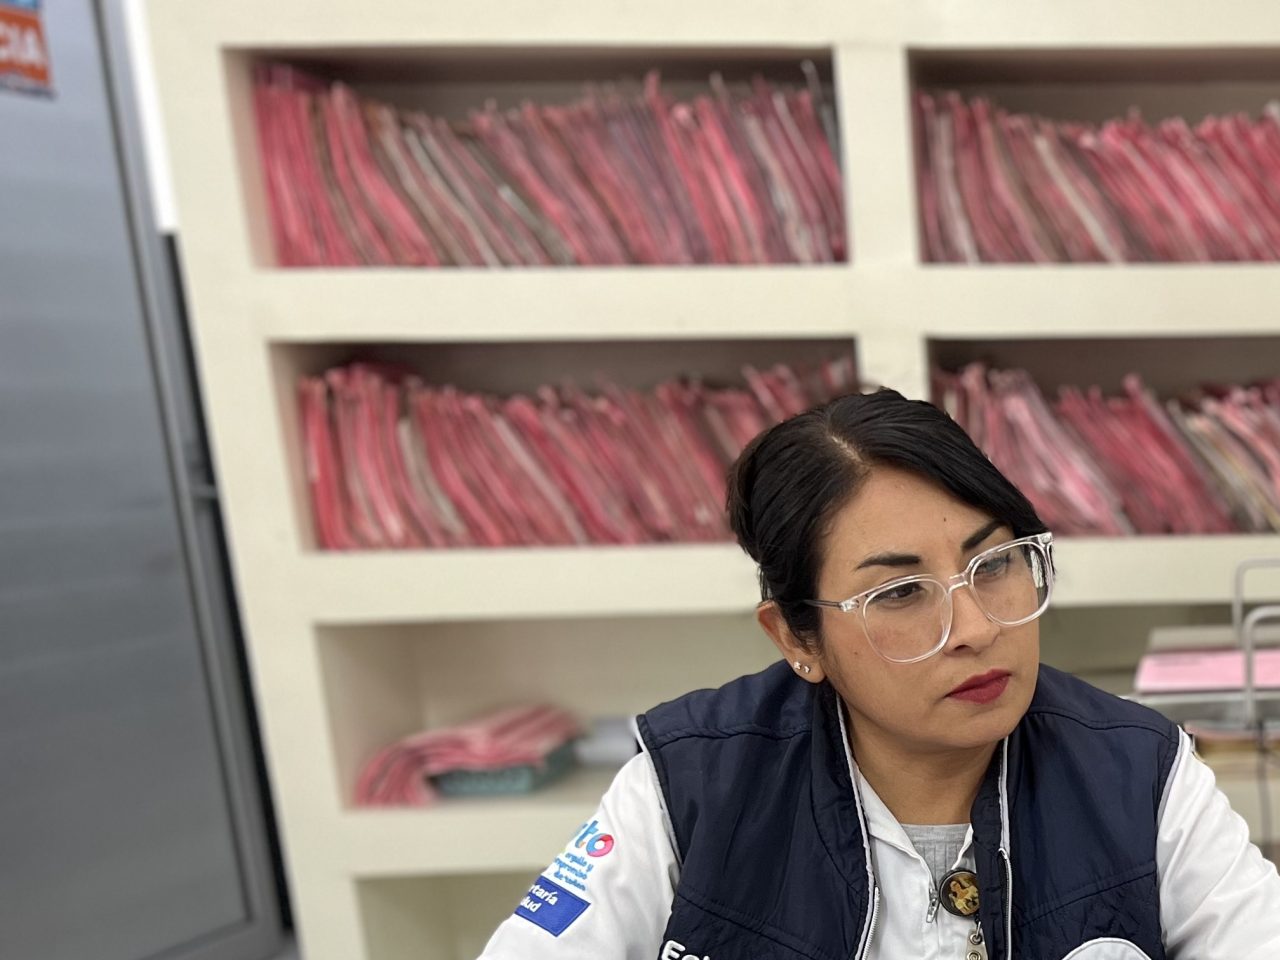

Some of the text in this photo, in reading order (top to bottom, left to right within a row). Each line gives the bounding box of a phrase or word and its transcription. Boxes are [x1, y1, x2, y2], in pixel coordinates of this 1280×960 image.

[575, 820, 614, 857] to
[520, 896, 542, 913] lud
[530, 884, 558, 906] taría
